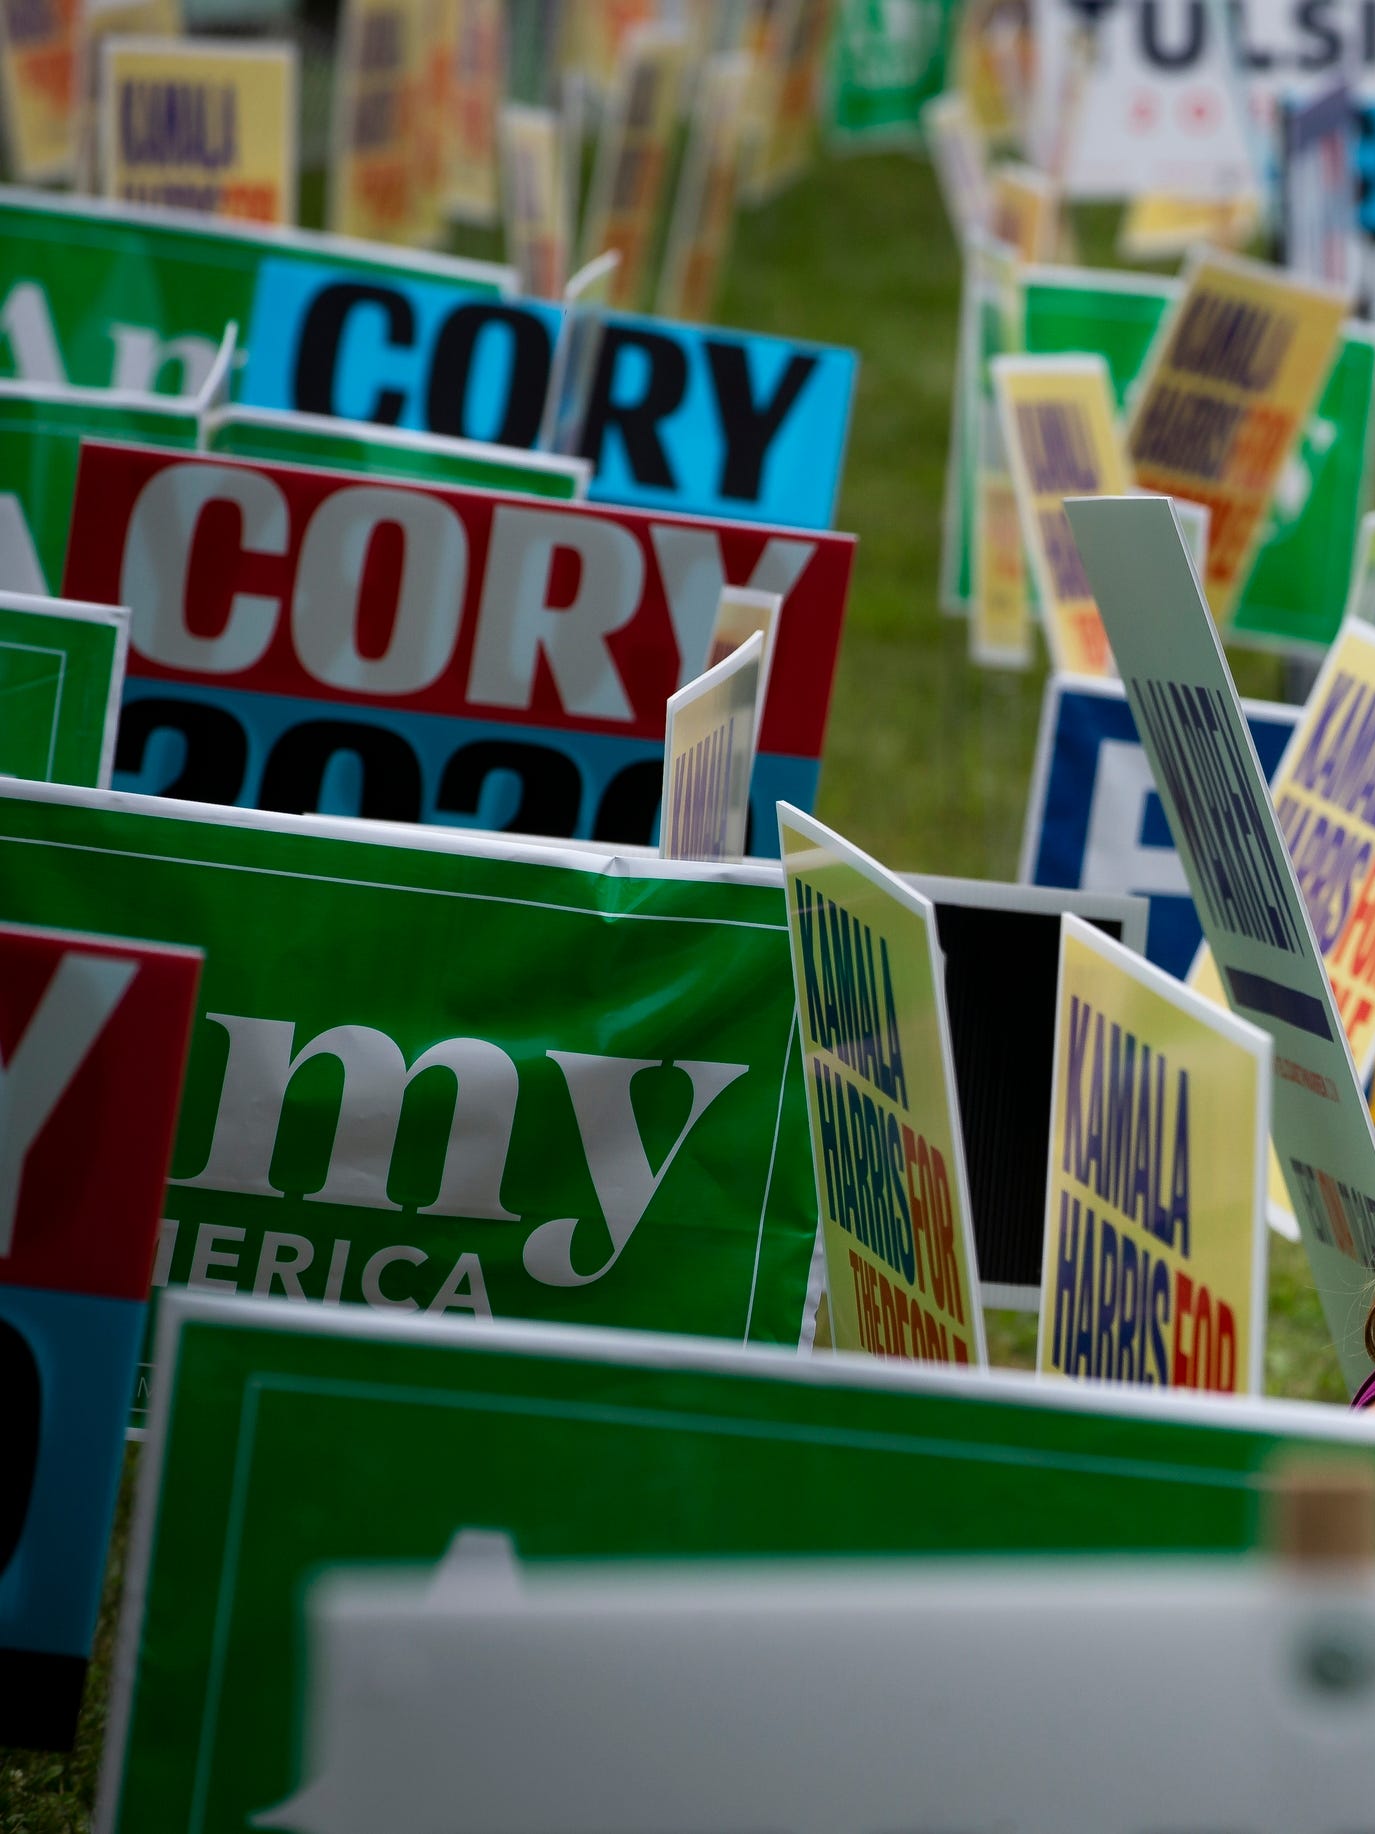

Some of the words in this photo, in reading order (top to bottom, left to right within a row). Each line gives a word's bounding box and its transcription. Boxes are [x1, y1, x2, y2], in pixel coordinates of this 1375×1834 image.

[292, 282, 820, 507] CORY
[118, 462, 817, 723] CORY
[1126, 676, 1307, 960] WARREN
[795, 877, 910, 1112] KAMALA
[163, 1012, 751, 1289] my
[813, 1055, 917, 1287] HARRIS
[901, 1122, 966, 1328] FOR
[1062, 994, 1191, 1263] KAMALA
[1051, 1188, 1171, 1393] HARRIS
